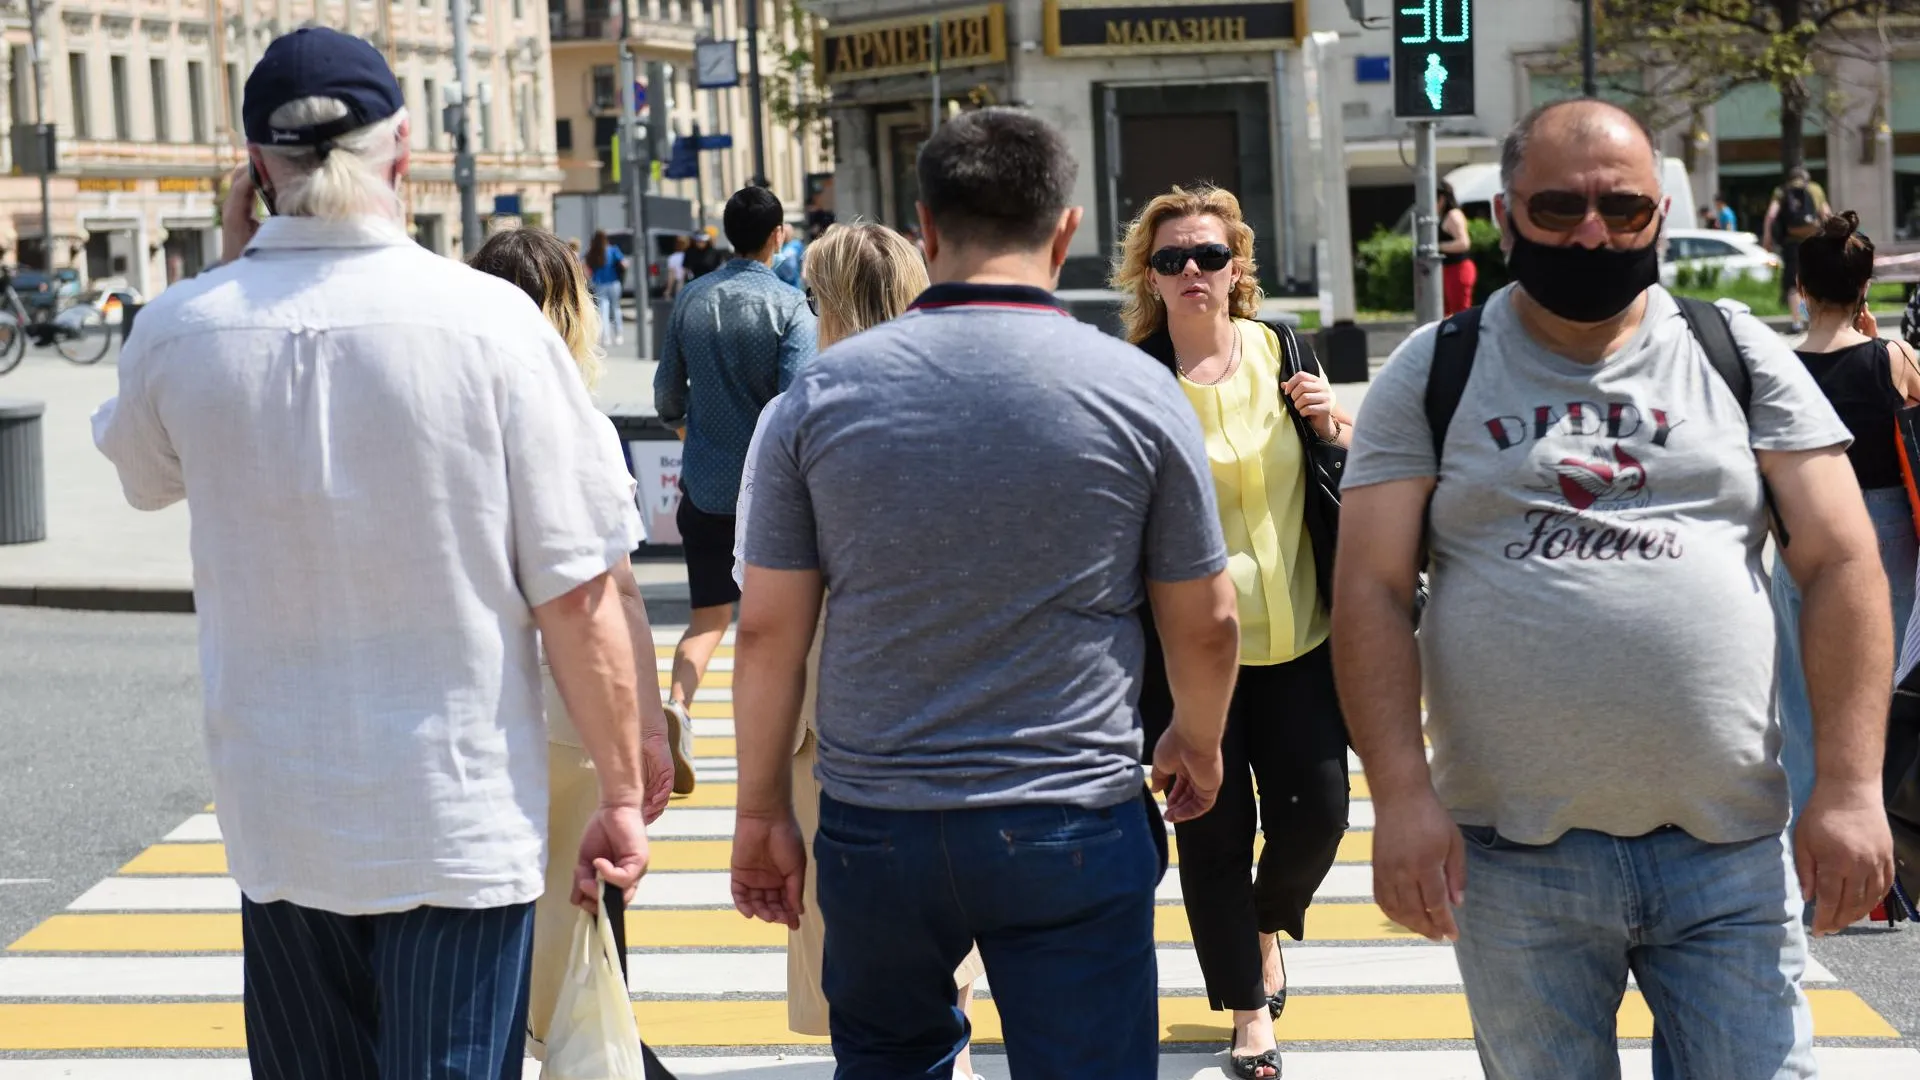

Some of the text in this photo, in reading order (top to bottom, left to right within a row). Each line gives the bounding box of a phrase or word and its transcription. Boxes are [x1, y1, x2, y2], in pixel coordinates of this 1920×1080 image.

[834, 15, 986, 73] АРМЕНИЯ
[1105, 16, 1247, 45] МАГАЗИН
[1401, 0, 1468, 43] 30
[1504, 509, 1683, 560] Forever
